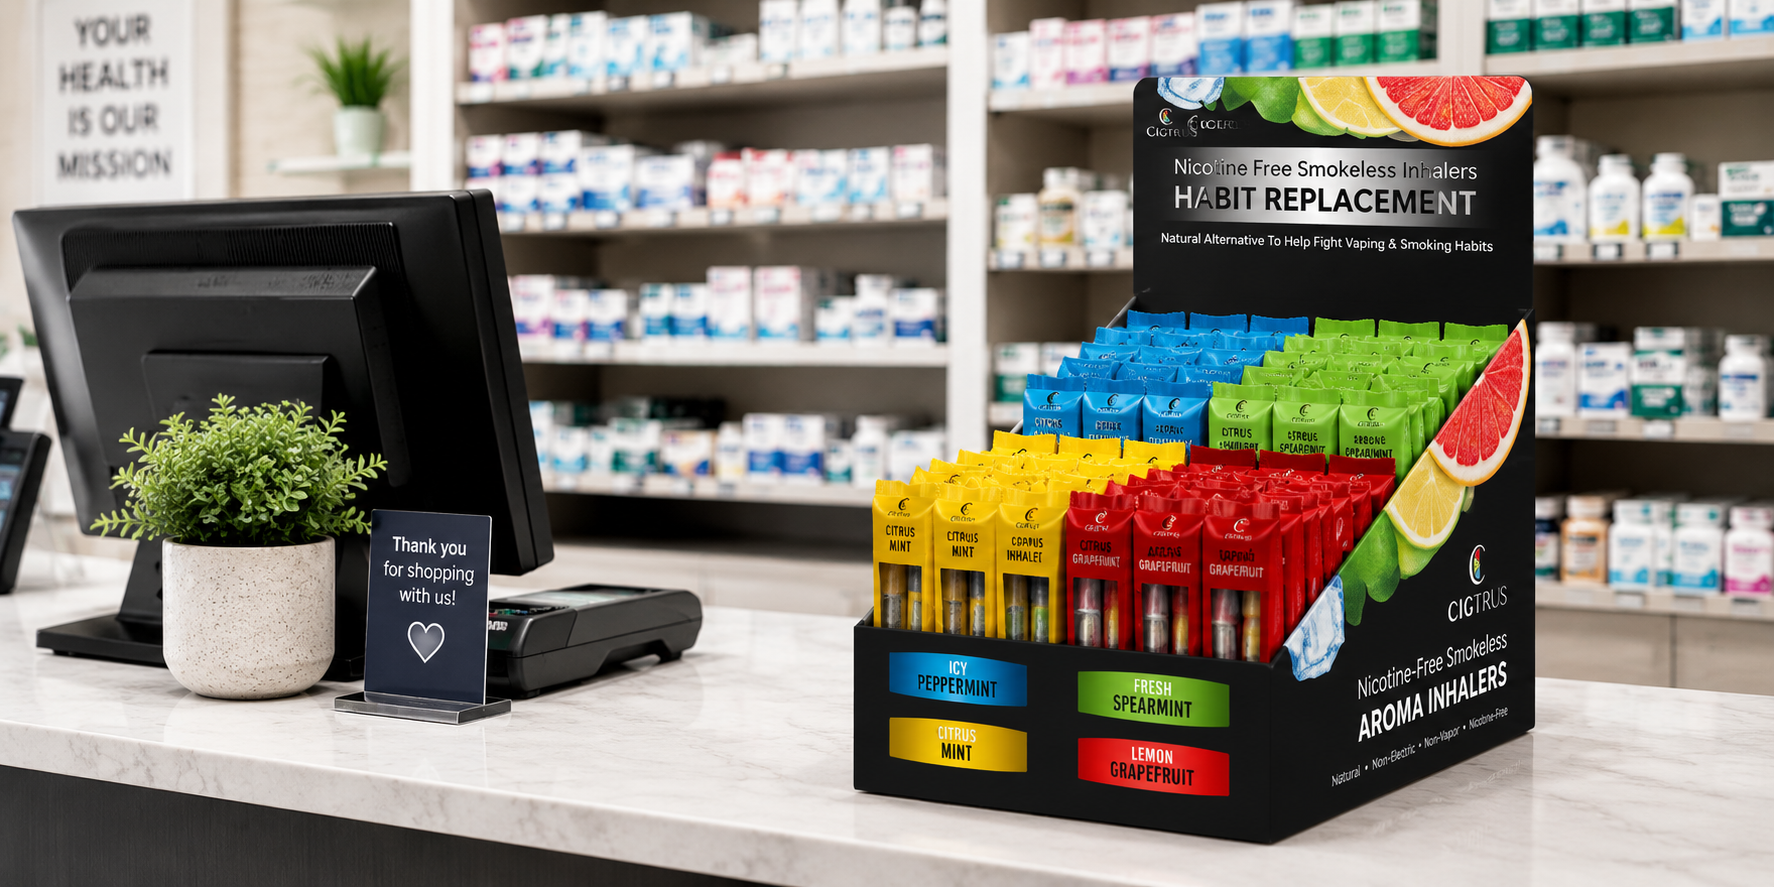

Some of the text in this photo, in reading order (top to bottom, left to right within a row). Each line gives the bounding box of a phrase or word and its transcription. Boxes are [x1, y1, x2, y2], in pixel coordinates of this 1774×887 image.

[74, 13, 152, 47] YOUR
[58, 58, 169, 94] HEALTH
[68, 103, 159, 137] IS OUR
[58, 150, 172, 181] MISSION
[1174, 158, 1477, 180] Nicotine Free Smokeless Inhalers
[1174, 186, 1476, 216] HABIT REPLACEMENT
[1161, 232, 1494, 253] Natural Alternative To Help Fight Vaping & Smoking Habits
[886, 525, 915, 537] CITRUS
[392, 536, 467, 558] Thank you
[890, 540, 911, 552] MINT
[384, 561, 474, 586] for shopping
[399, 588, 456, 606] with us!
[1448, 585, 1507, 622] CIGTRUS
[949, 660, 967, 676] ICY
[1357, 633, 1507, 699] Nicotine-Free Smokeless
[917, 675, 997, 698] PEPPERMINT
[1134, 678, 1172, 696] FRESH
[1113, 695, 1192, 718] SPEARMINT
[1358, 660, 1507, 742] AROMA INHALERS
[937, 726, 976, 742] CITRUS
[941, 743, 972, 762] MINT
[1131, 746, 1173, 765] LEMON
[1110, 761, 1194, 786] GRAPEFRUIT
[1331, 765, 1361, 786] Natural
